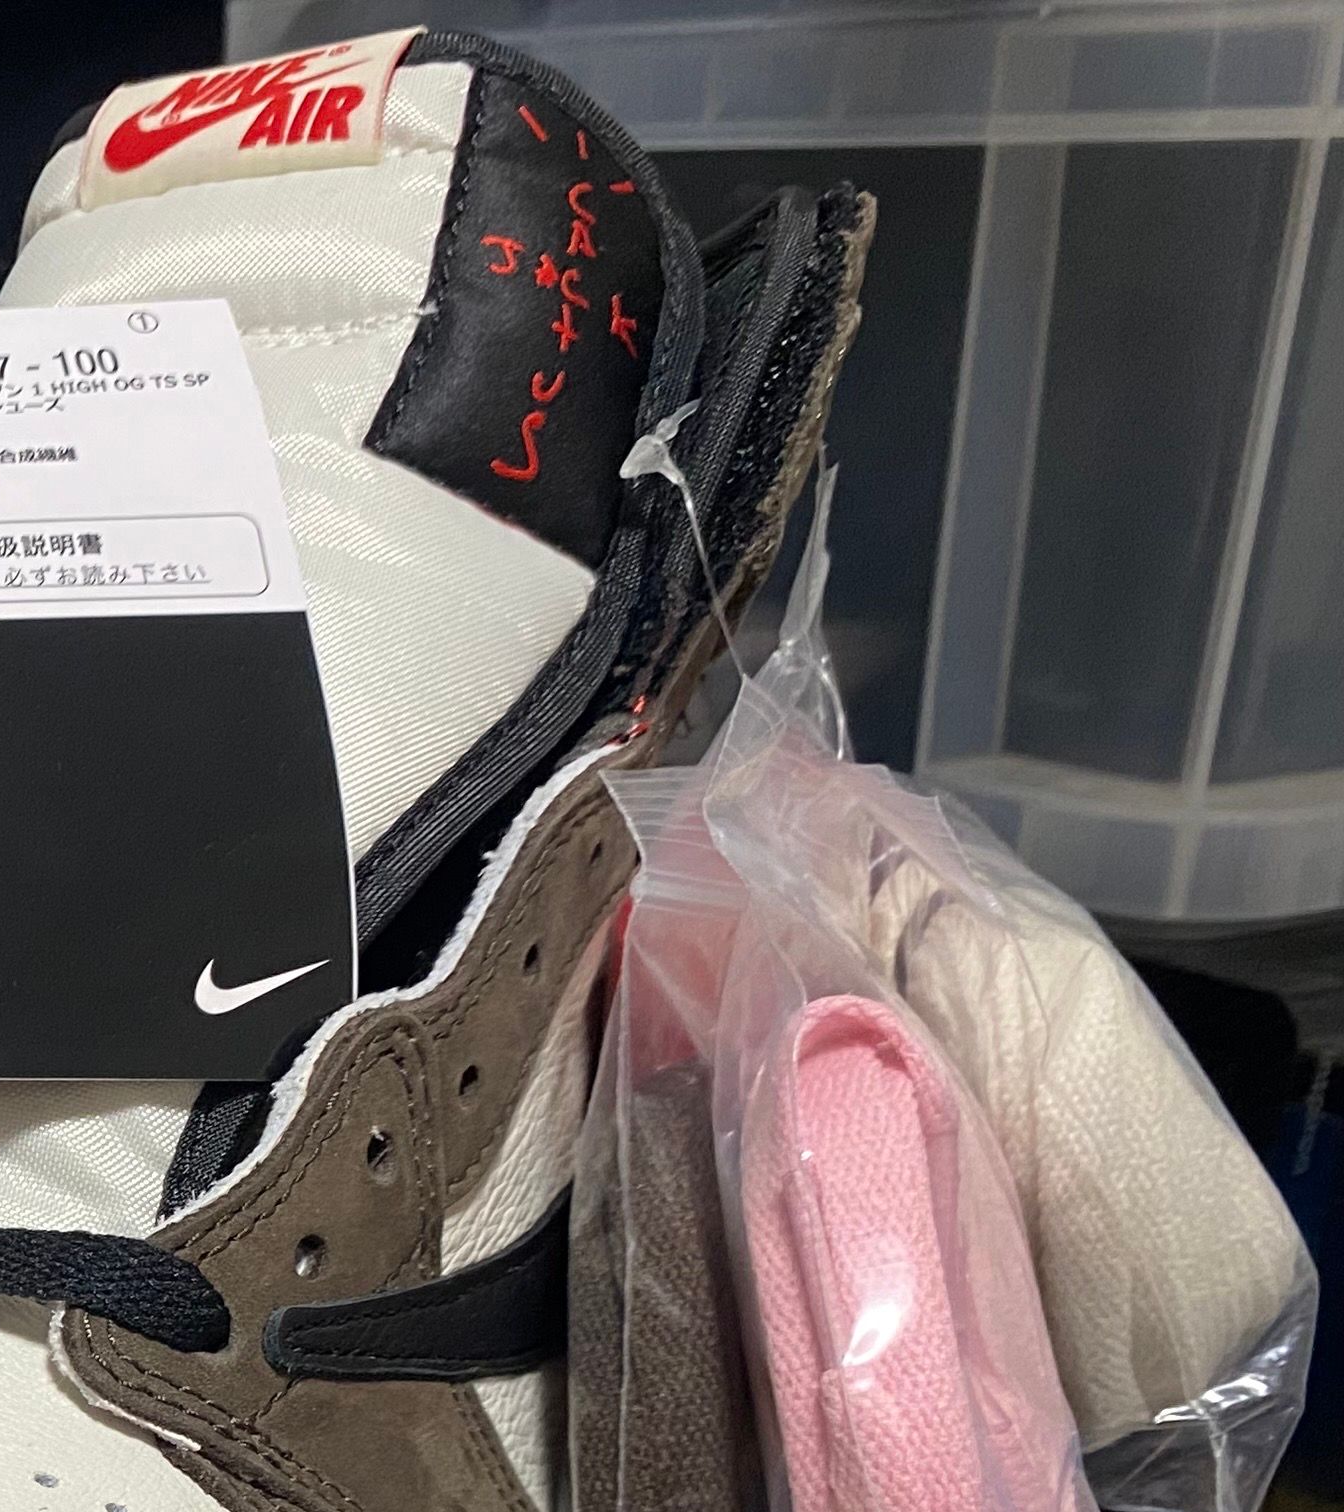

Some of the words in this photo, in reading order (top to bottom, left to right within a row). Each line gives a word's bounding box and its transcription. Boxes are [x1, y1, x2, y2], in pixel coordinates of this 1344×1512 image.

[238, 86, 365, 150] AIR
[55, 347, 120, 378] 100
[51, 378, 108, 396] HIGH
[114, 376, 146, 391] OG
[149, 375, 177, 389] TS
[183, 373, 212, 387] SP
